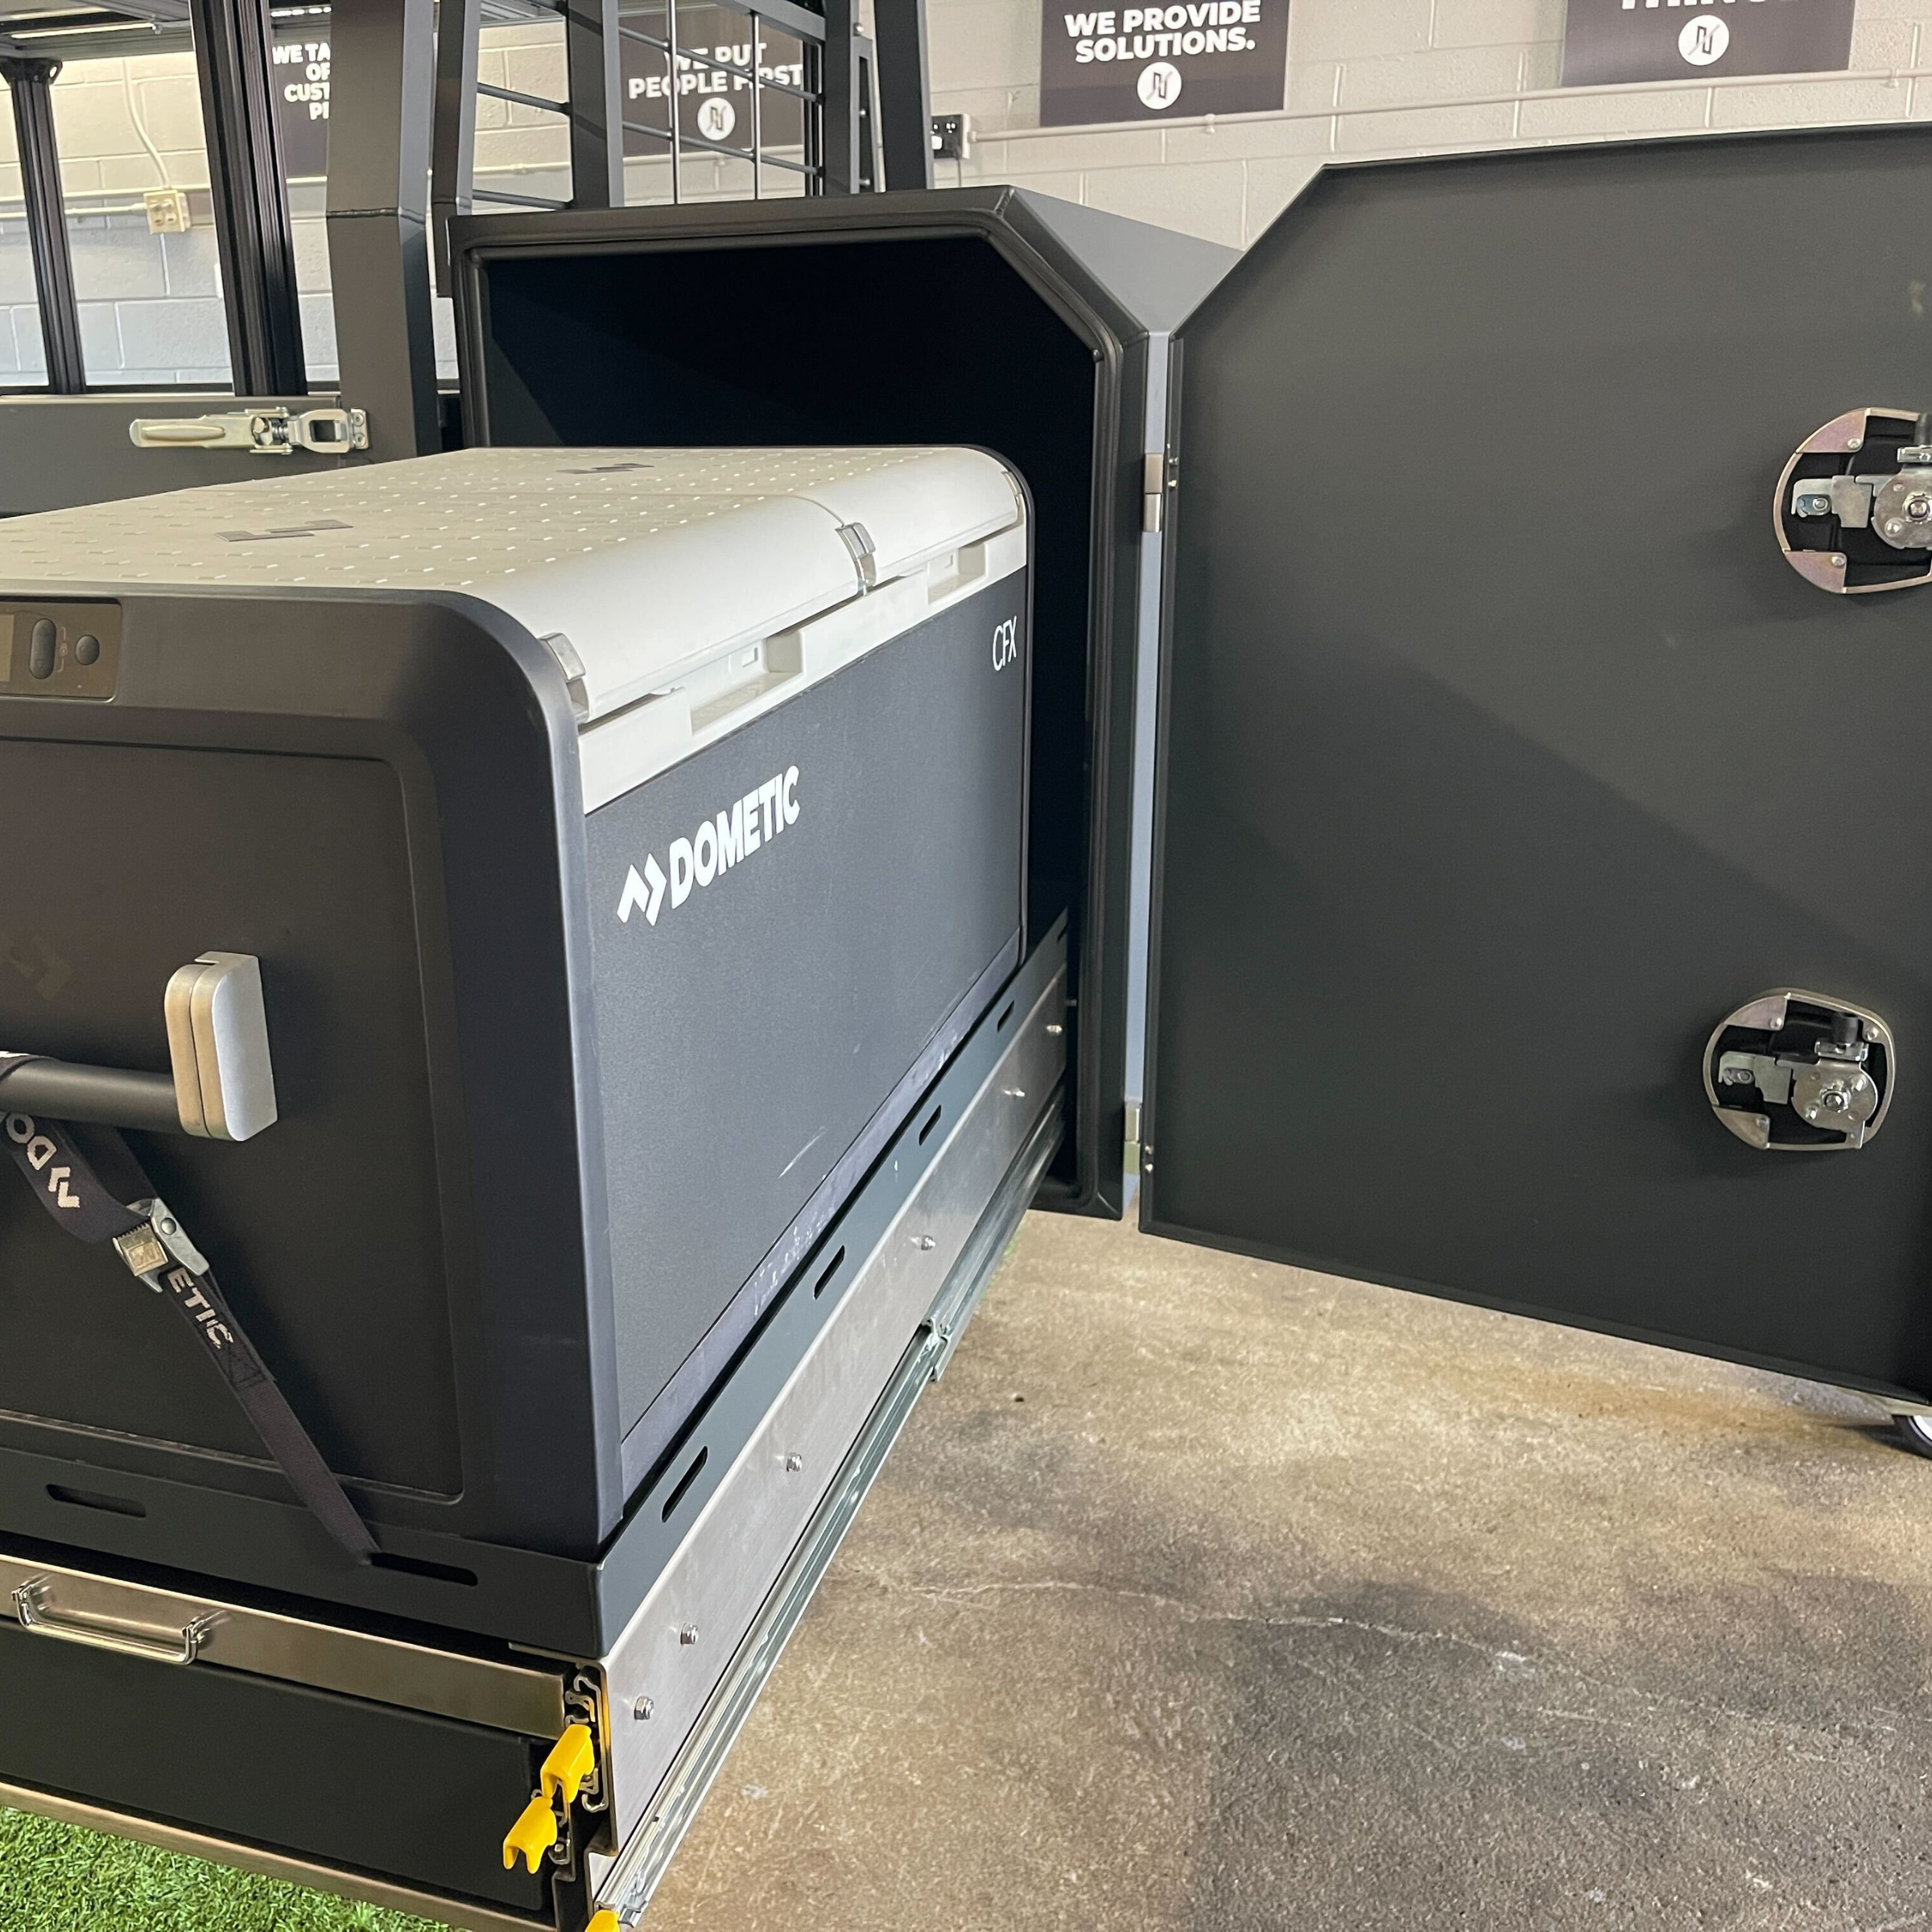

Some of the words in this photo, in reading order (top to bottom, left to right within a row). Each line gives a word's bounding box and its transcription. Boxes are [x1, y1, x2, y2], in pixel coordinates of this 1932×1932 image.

[1064, 11, 1116, 37] WE
[1123, 0, 1261, 33] PROVIDE
[272, 44, 303, 64] WE
[1075, 27, 1256, 64] SOLUTIONS.
[629, 71, 728, 99] PEOPLE
[993, 616, 1017, 671] CFX
[669, 765, 800, 910] DOMETIC
